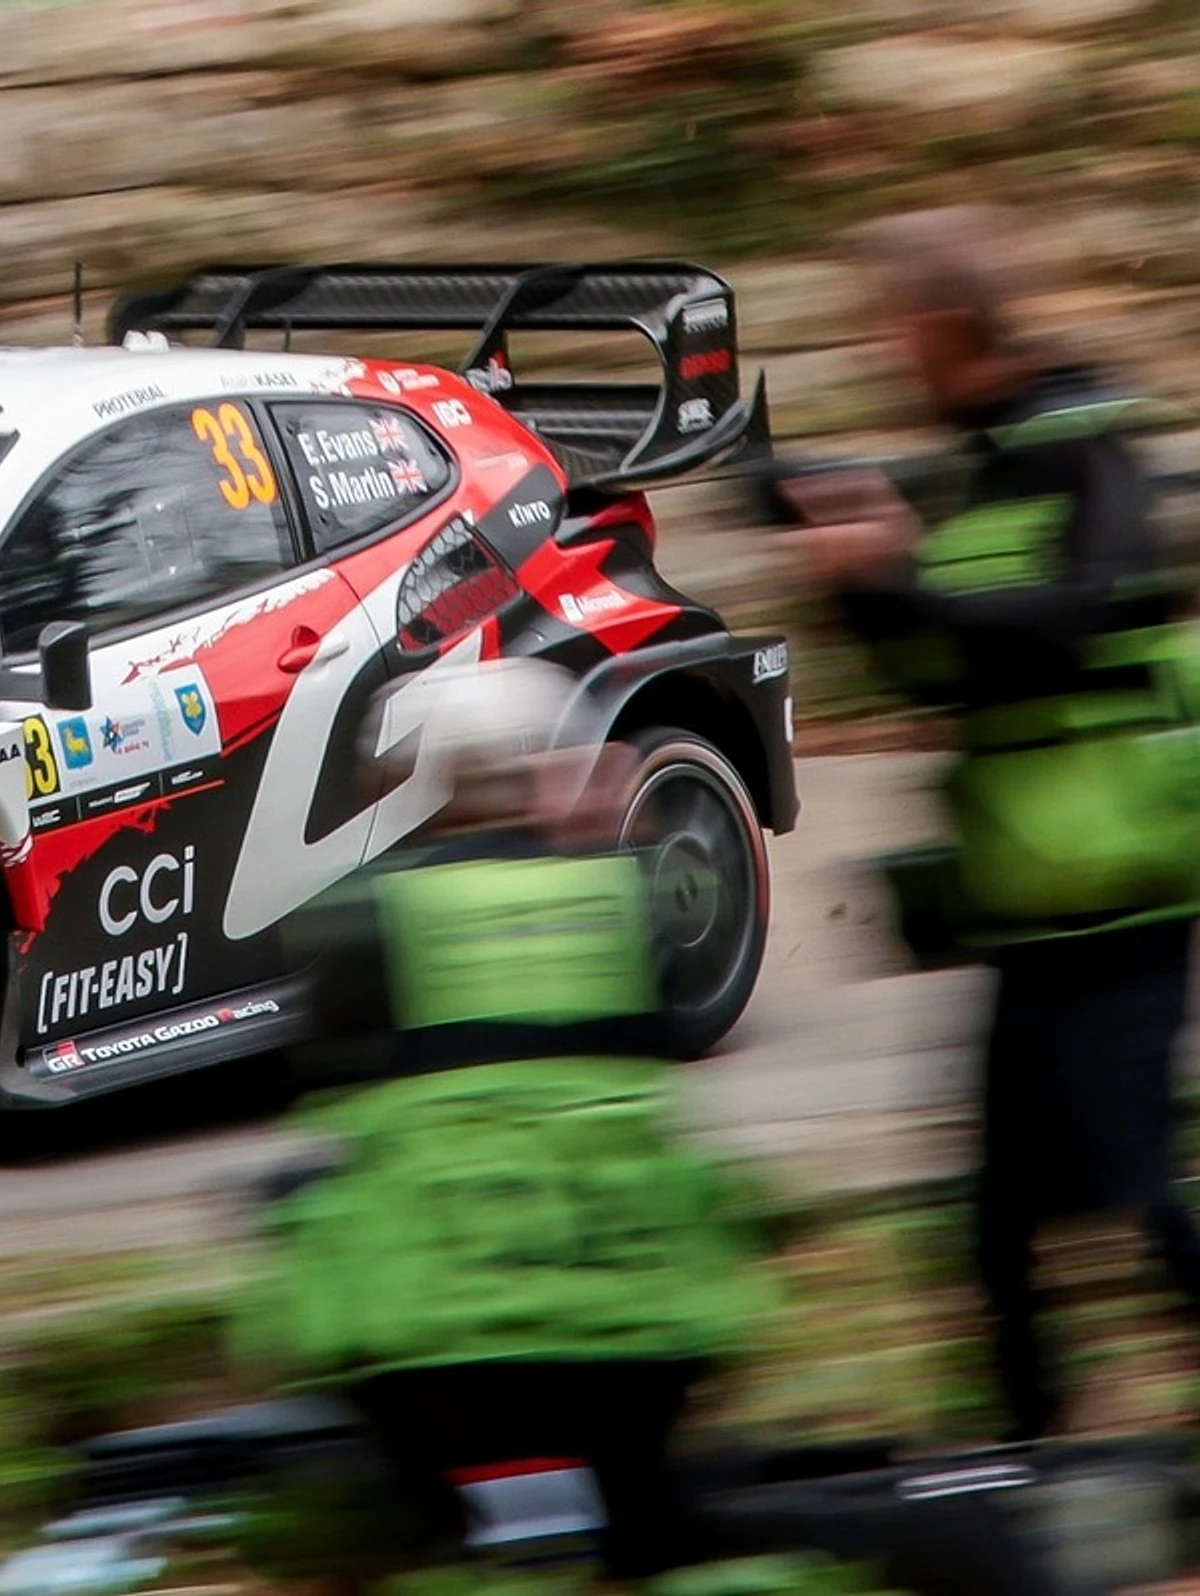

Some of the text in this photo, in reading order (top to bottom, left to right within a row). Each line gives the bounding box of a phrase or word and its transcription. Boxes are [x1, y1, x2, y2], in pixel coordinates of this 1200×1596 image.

[191, 402, 277, 511] 33
[297, 430, 379, 467] E.Evans
[309, 466, 396, 510] S.Martin
[24, 716, 58, 799] 3
[217, 999, 280, 1024] Racing
